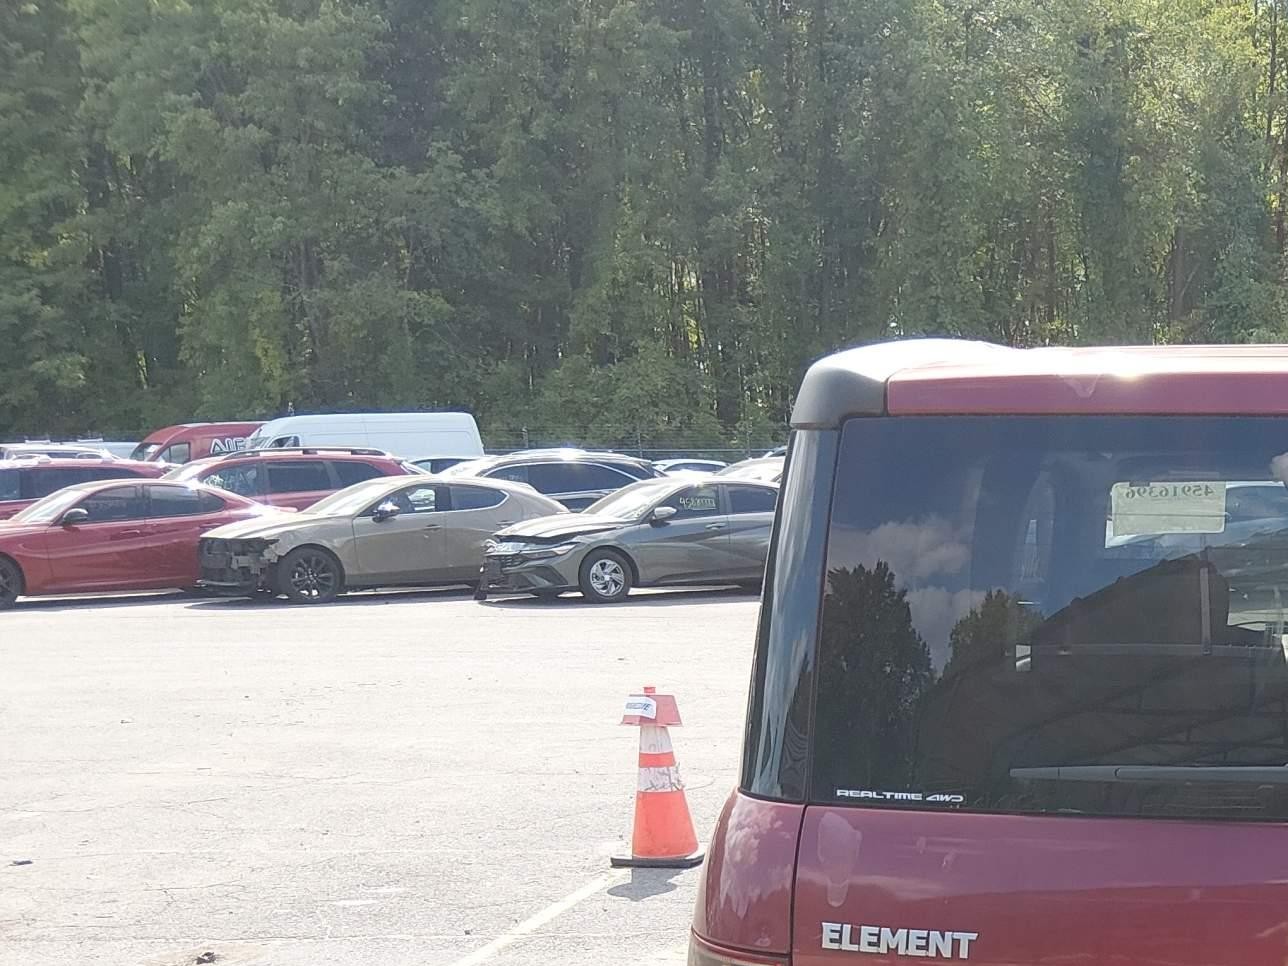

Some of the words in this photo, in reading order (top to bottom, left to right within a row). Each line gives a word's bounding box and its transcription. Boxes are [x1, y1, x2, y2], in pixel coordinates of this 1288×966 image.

[836, 789, 923, 801] REALTIME
[925, 794, 964, 802] 4WD
[821, 922, 979, 959] ELEMENT
